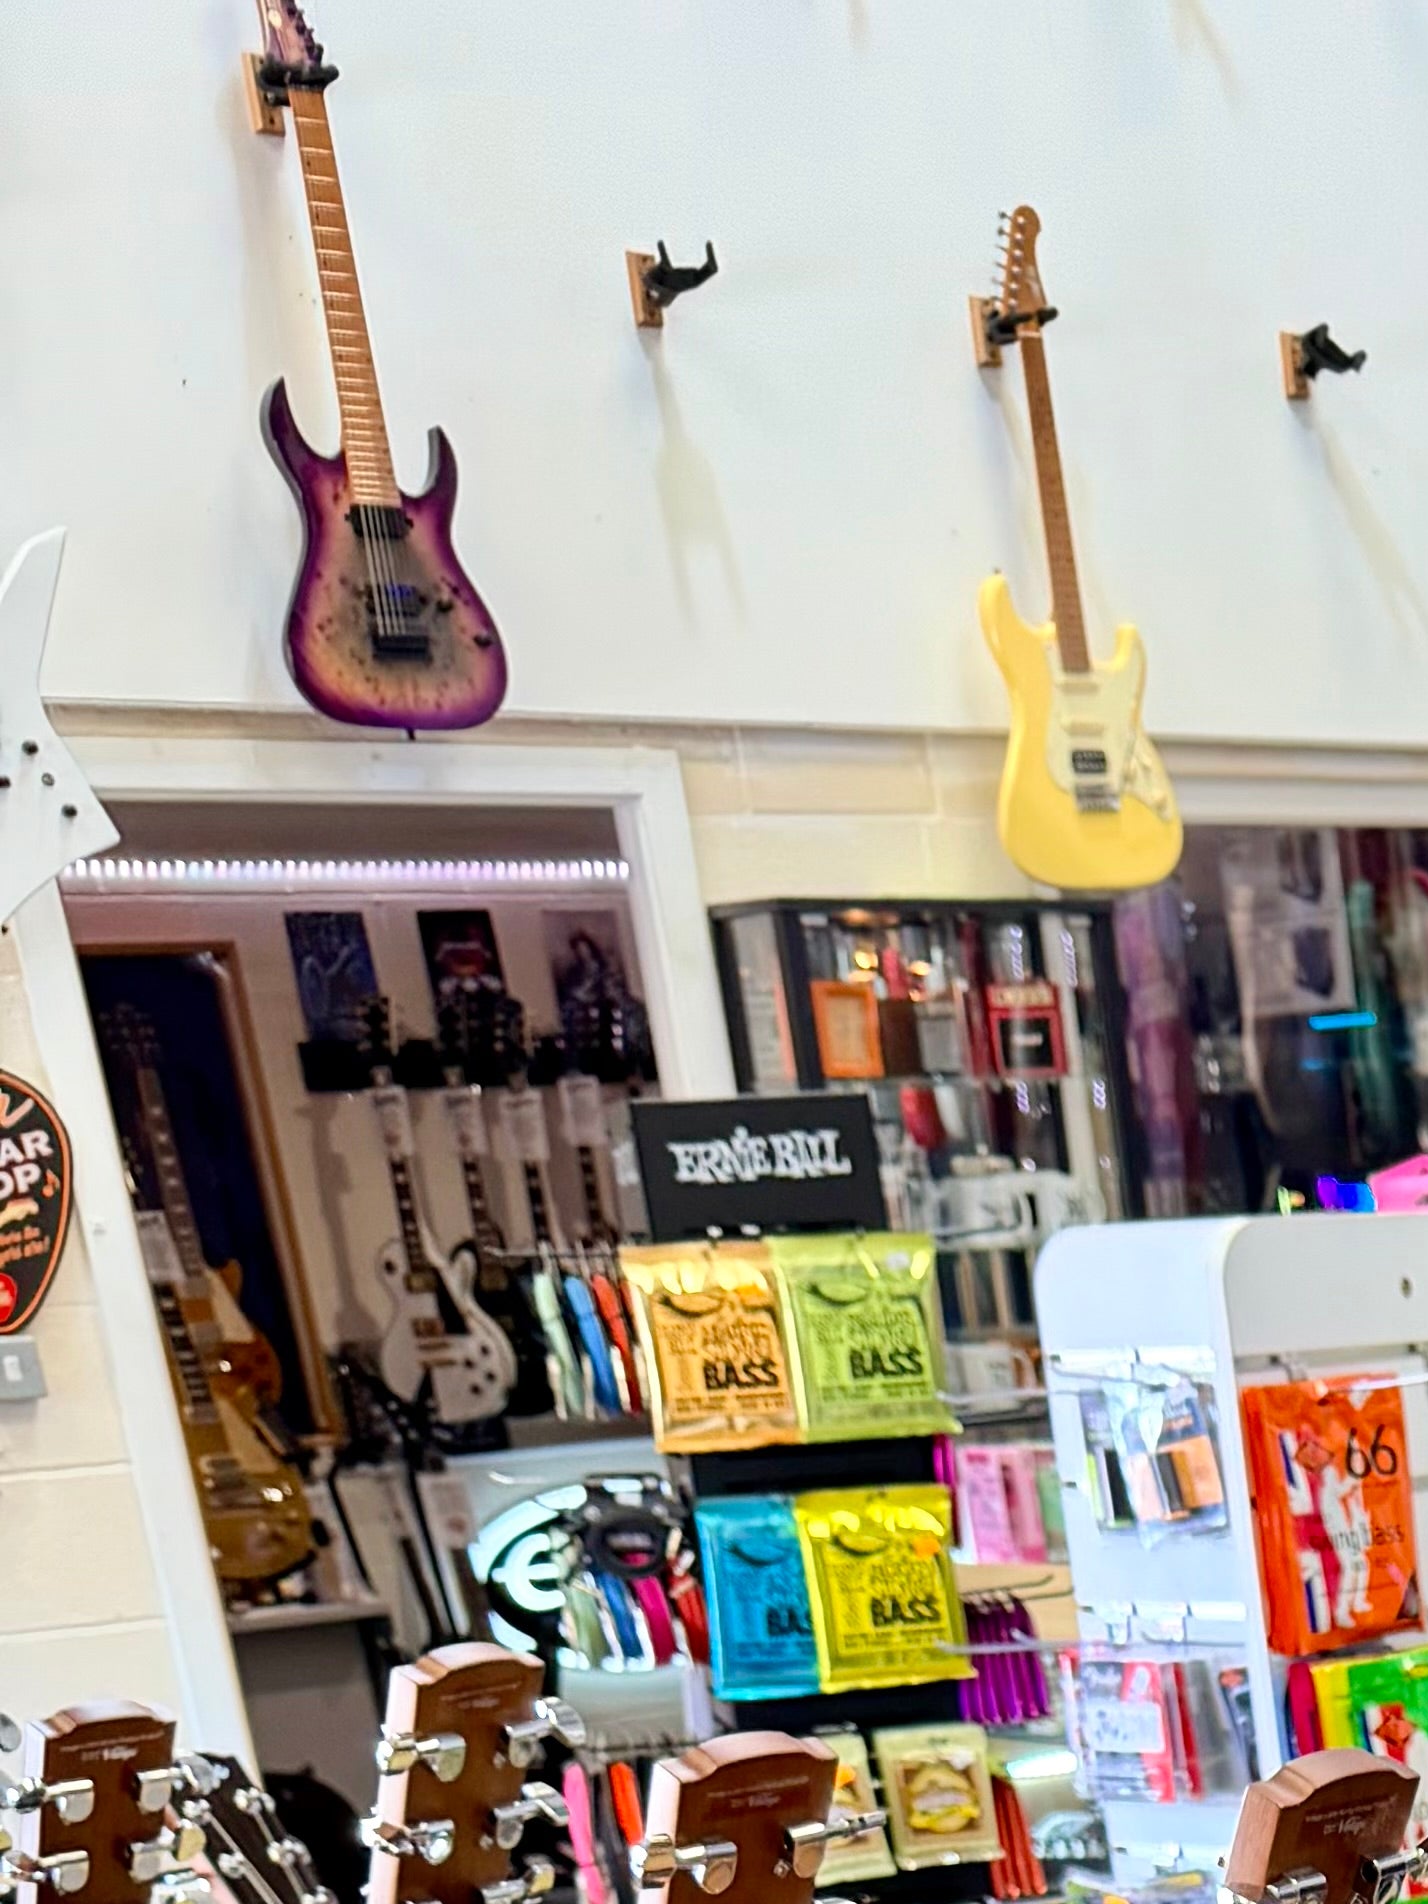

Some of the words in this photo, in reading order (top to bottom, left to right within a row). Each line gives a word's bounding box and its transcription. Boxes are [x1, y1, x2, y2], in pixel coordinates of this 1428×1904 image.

[667, 1126, 768, 1184] ERNIE
[768, 1127, 852, 1179] BALL
[702, 1358, 782, 1391] BASS
[850, 1349, 925, 1380] BASS
[1345, 1424, 1398, 1479] 66
[870, 1597, 942, 1628] BASS
